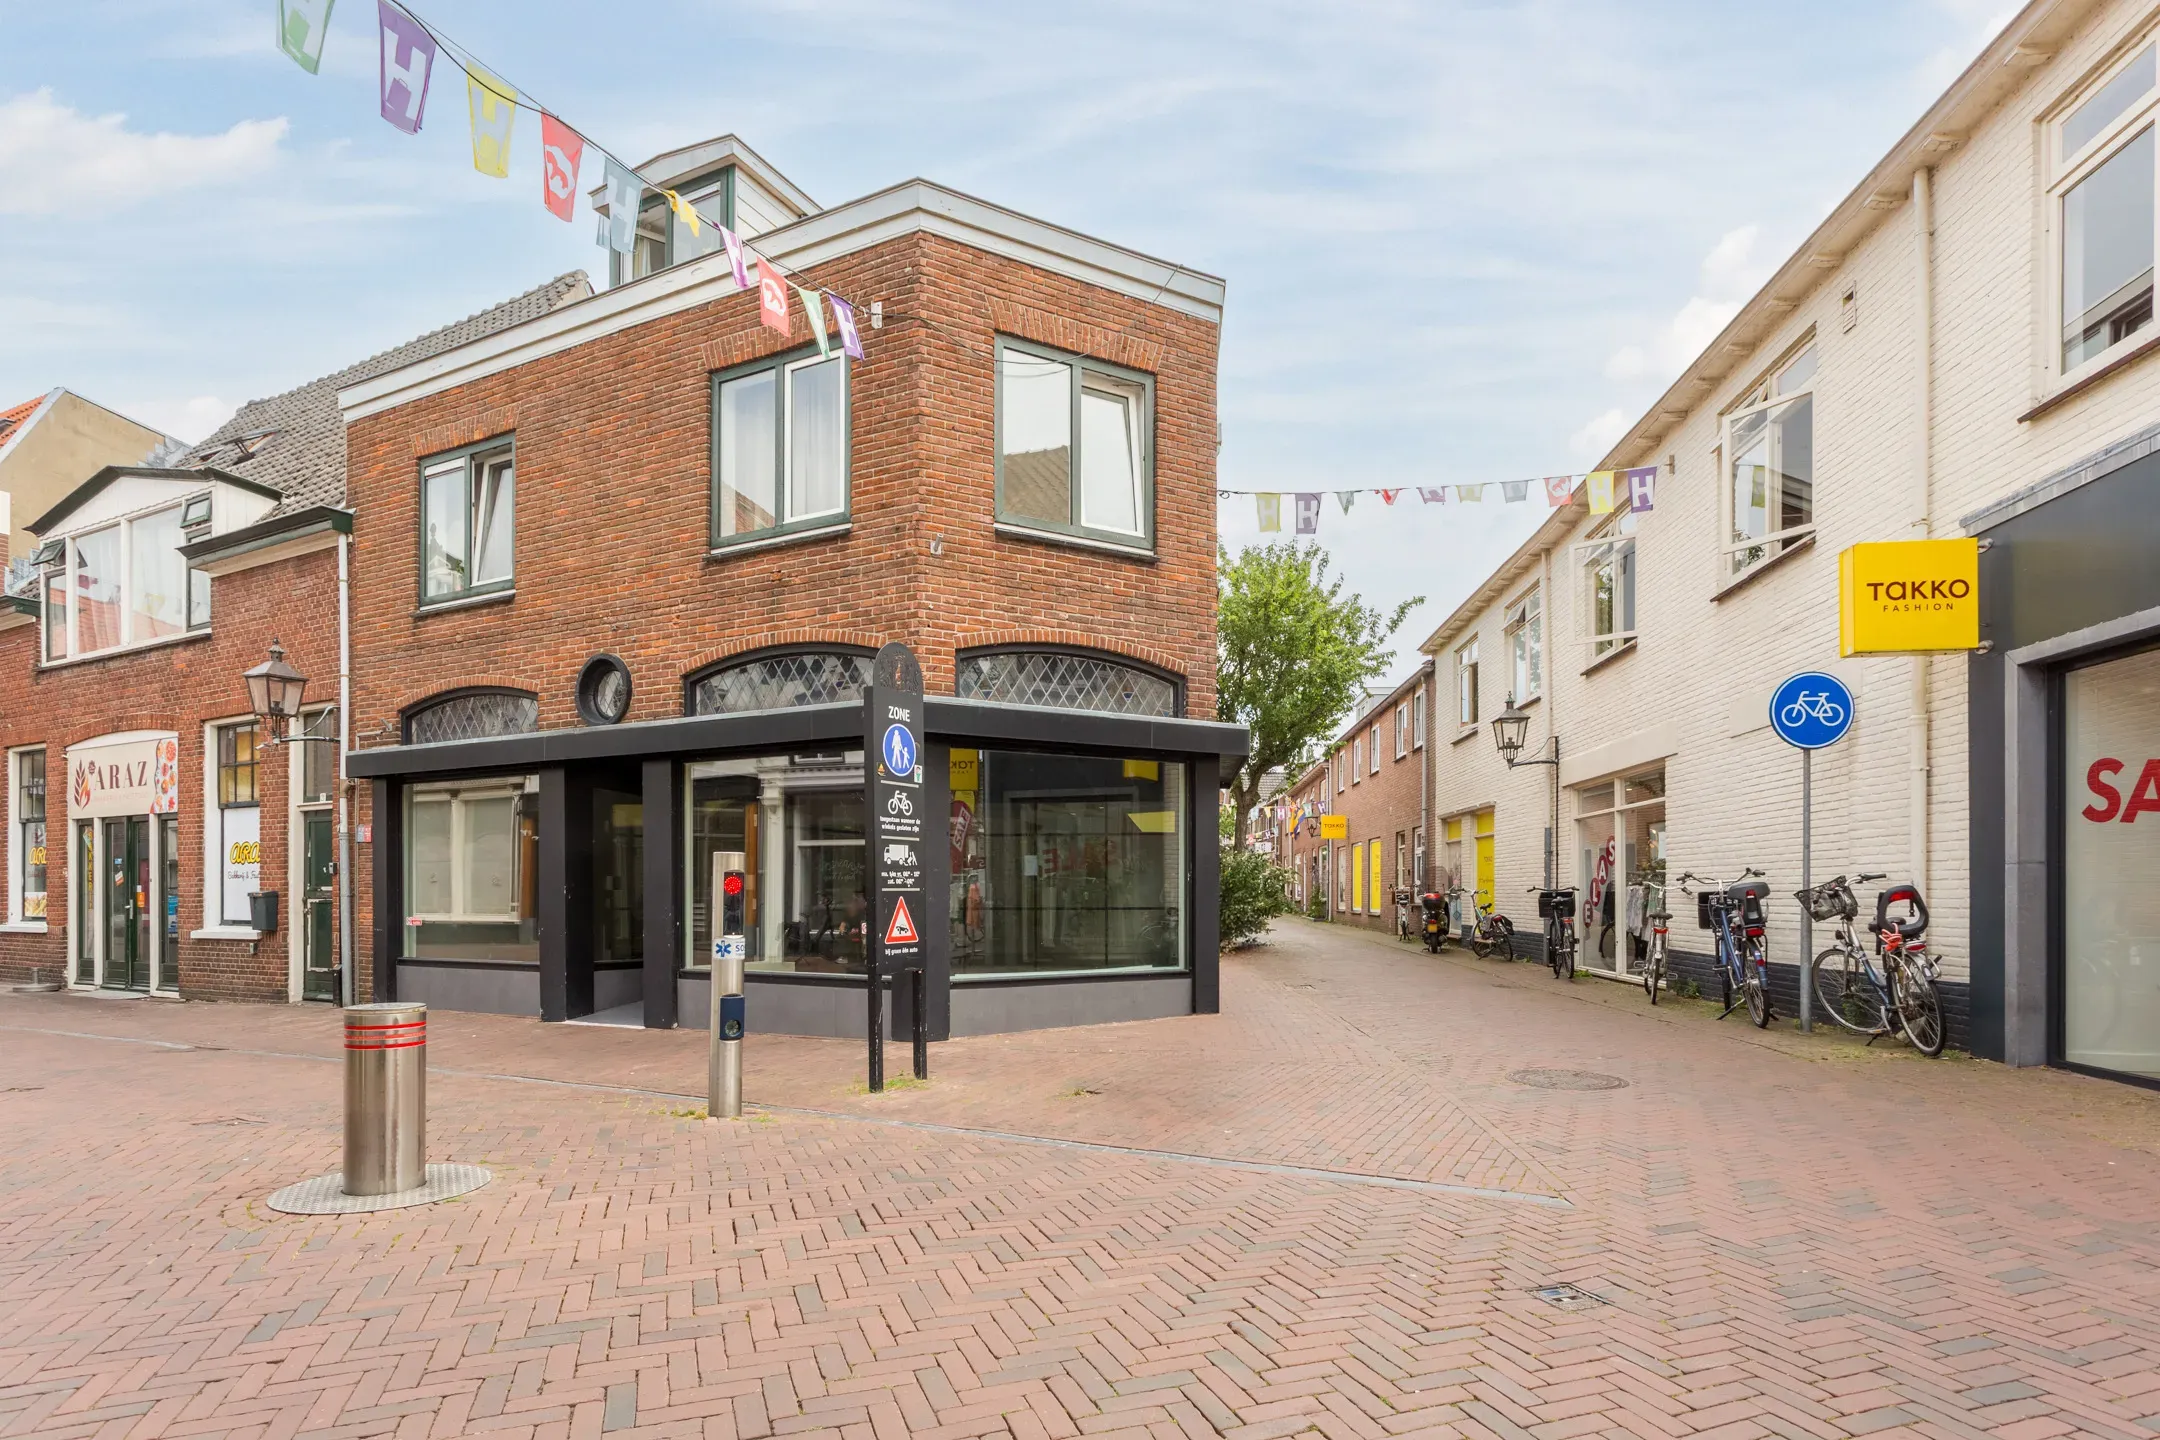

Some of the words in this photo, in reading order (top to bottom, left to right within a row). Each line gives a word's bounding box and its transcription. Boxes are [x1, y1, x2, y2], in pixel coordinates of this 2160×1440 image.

[1883, 603, 1954, 612] FASHION
[888, 705, 911, 722] ZONE
[95, 760, 148, 791] ARAZ
[2082, 757, 2160, 823] SA
